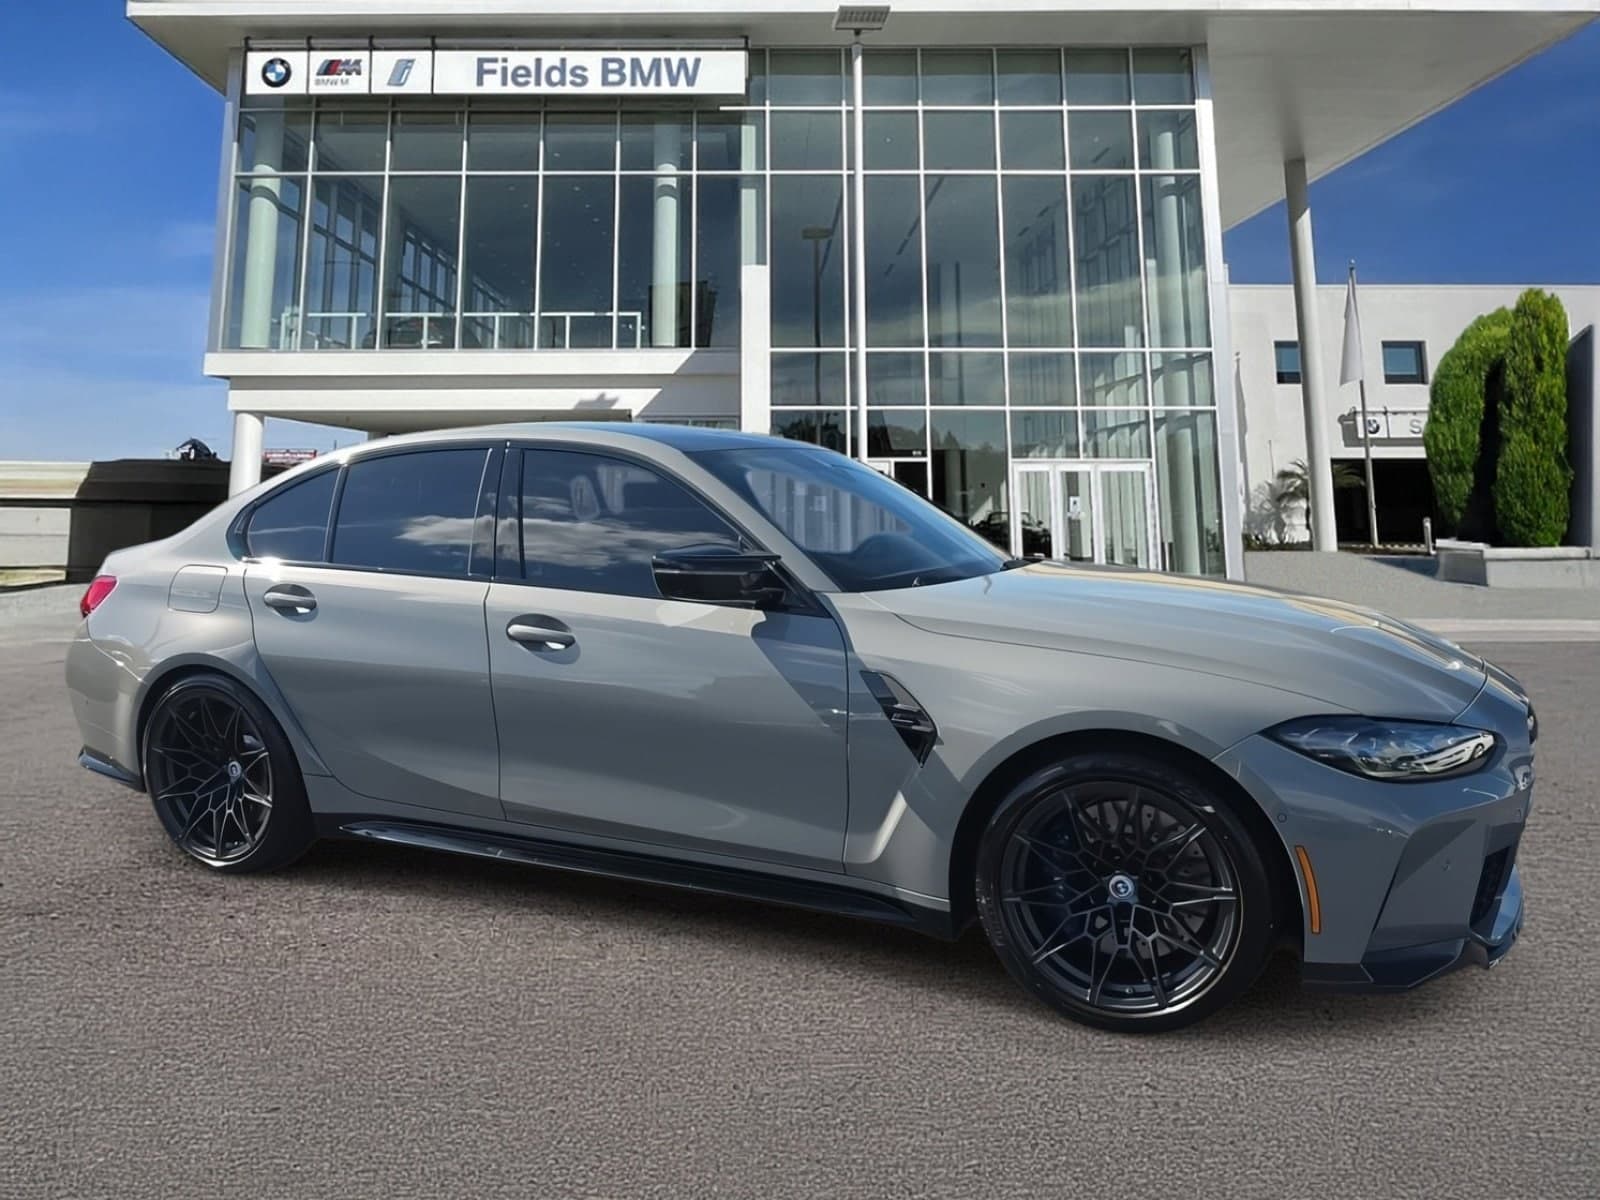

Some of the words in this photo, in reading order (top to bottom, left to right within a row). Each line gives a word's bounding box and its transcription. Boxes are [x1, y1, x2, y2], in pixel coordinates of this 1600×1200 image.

[315, 78, 339, 86] BMW
[476, 57, 589, 88] Fields
[601, 57, 702, 88] BMW
